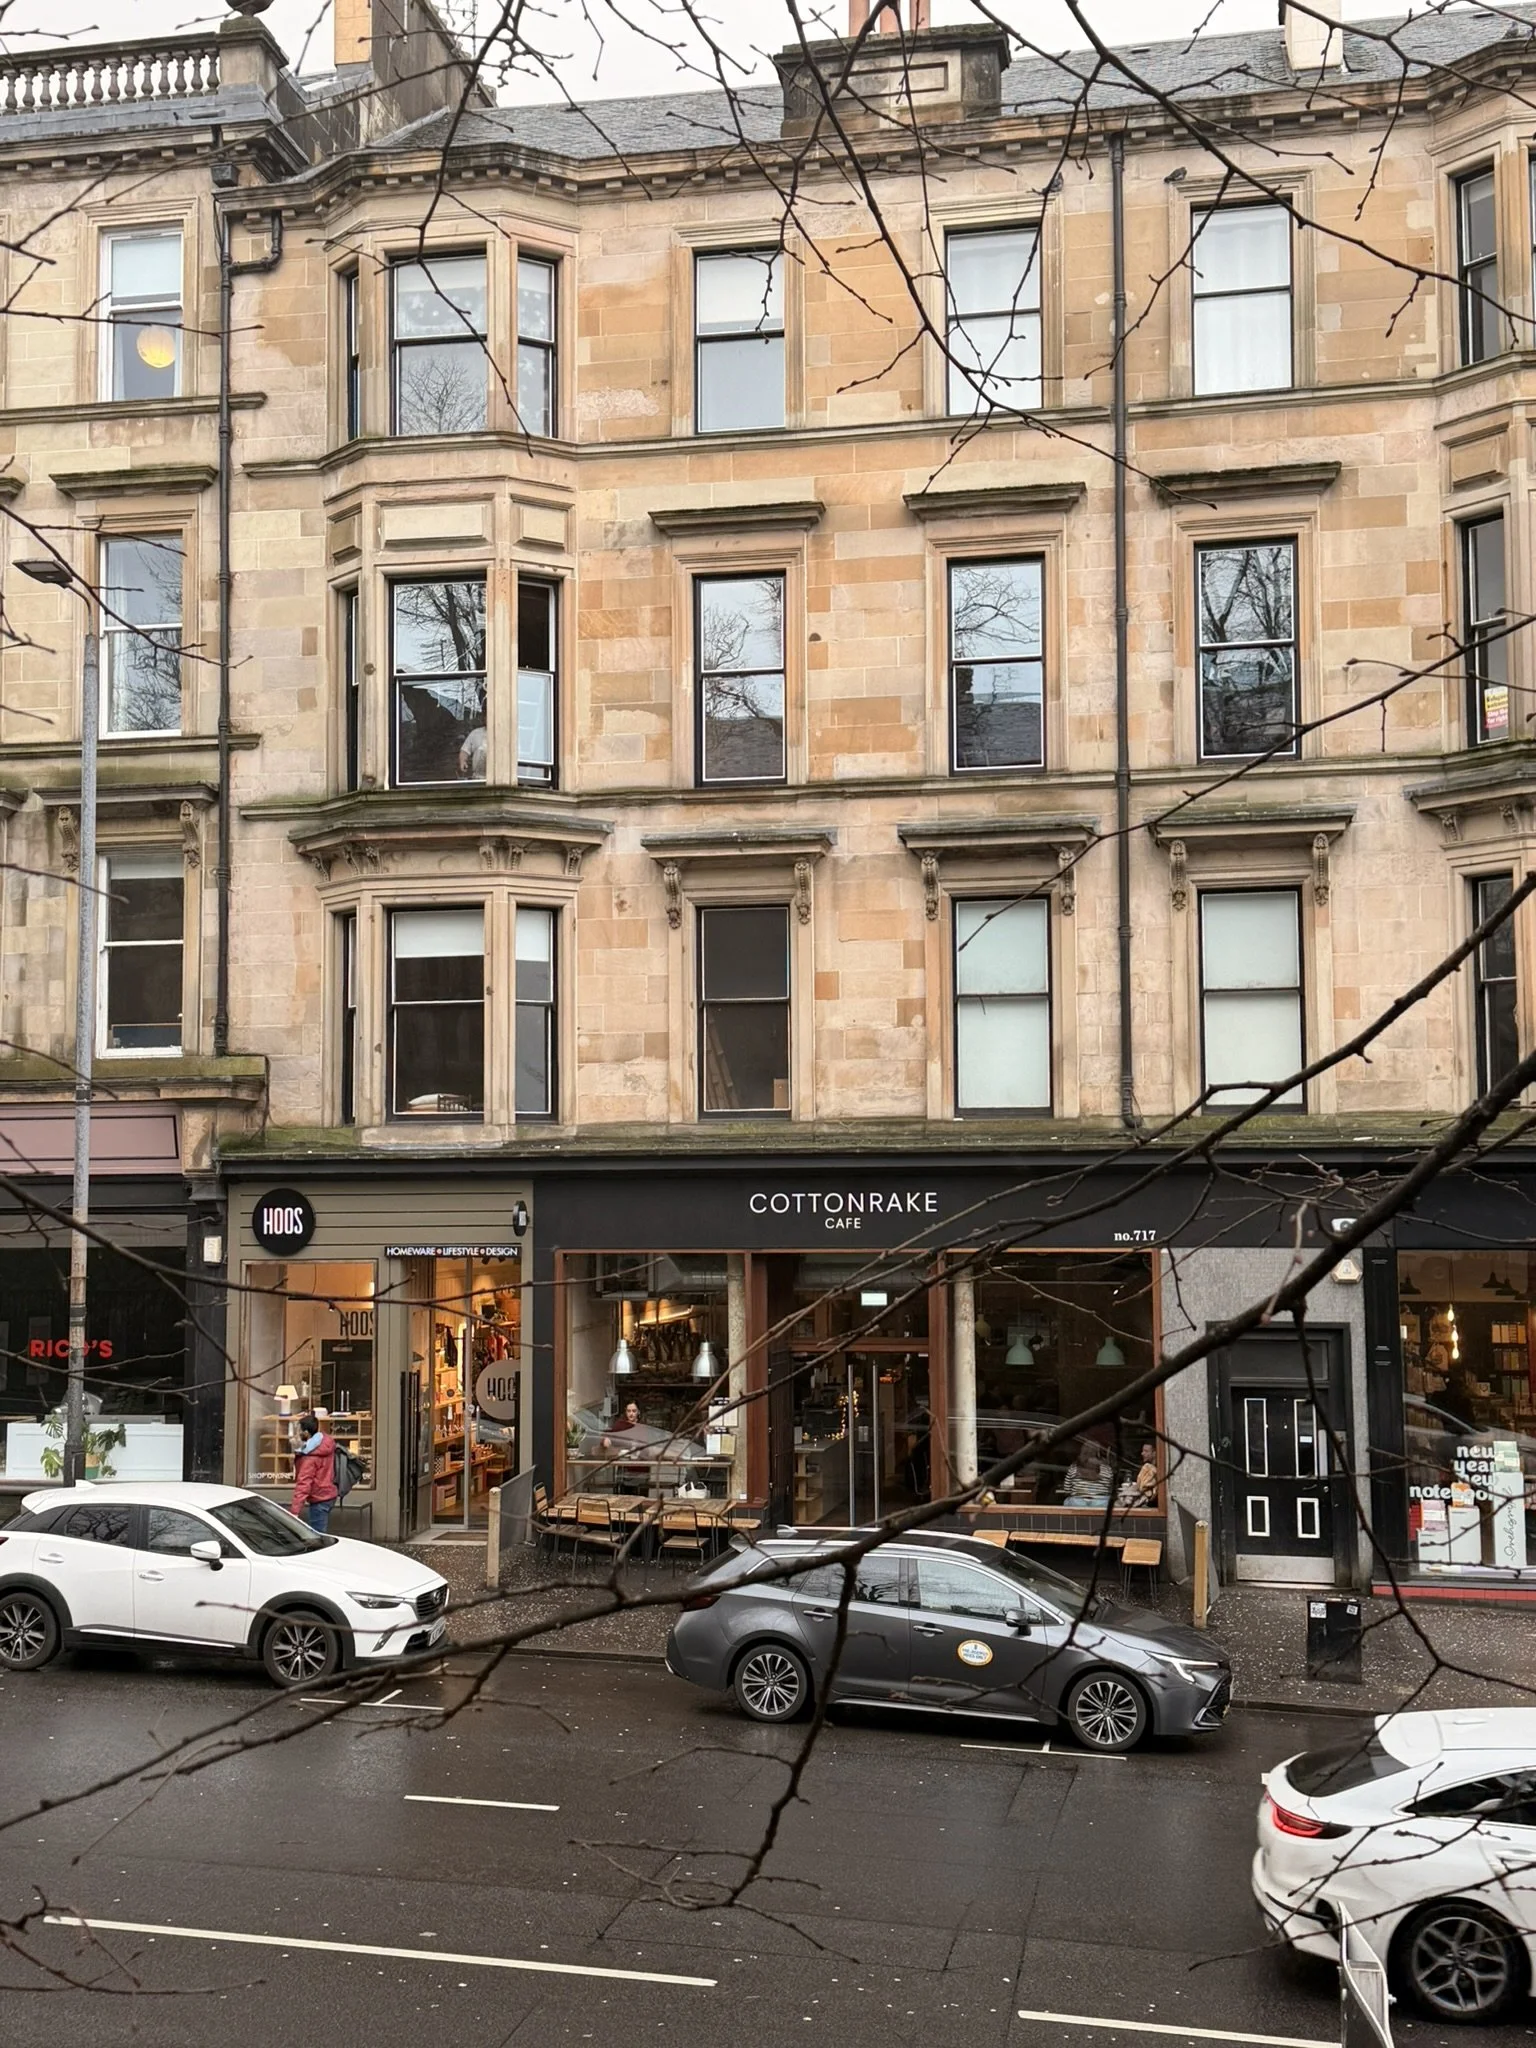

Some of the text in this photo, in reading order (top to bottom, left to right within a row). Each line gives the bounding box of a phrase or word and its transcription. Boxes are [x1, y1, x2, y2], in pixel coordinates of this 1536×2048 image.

[750, 1192, 937, 1213] COTTONRAKE
[263, 1207, 303, 1235] HOOS
[825, 1217, 861, 1229] CAFE
[1114, 1230, 1156, 1241] no.717
[387, 1247, 518, 1256] HOMEWARE LIFESTYLE DESIGN
